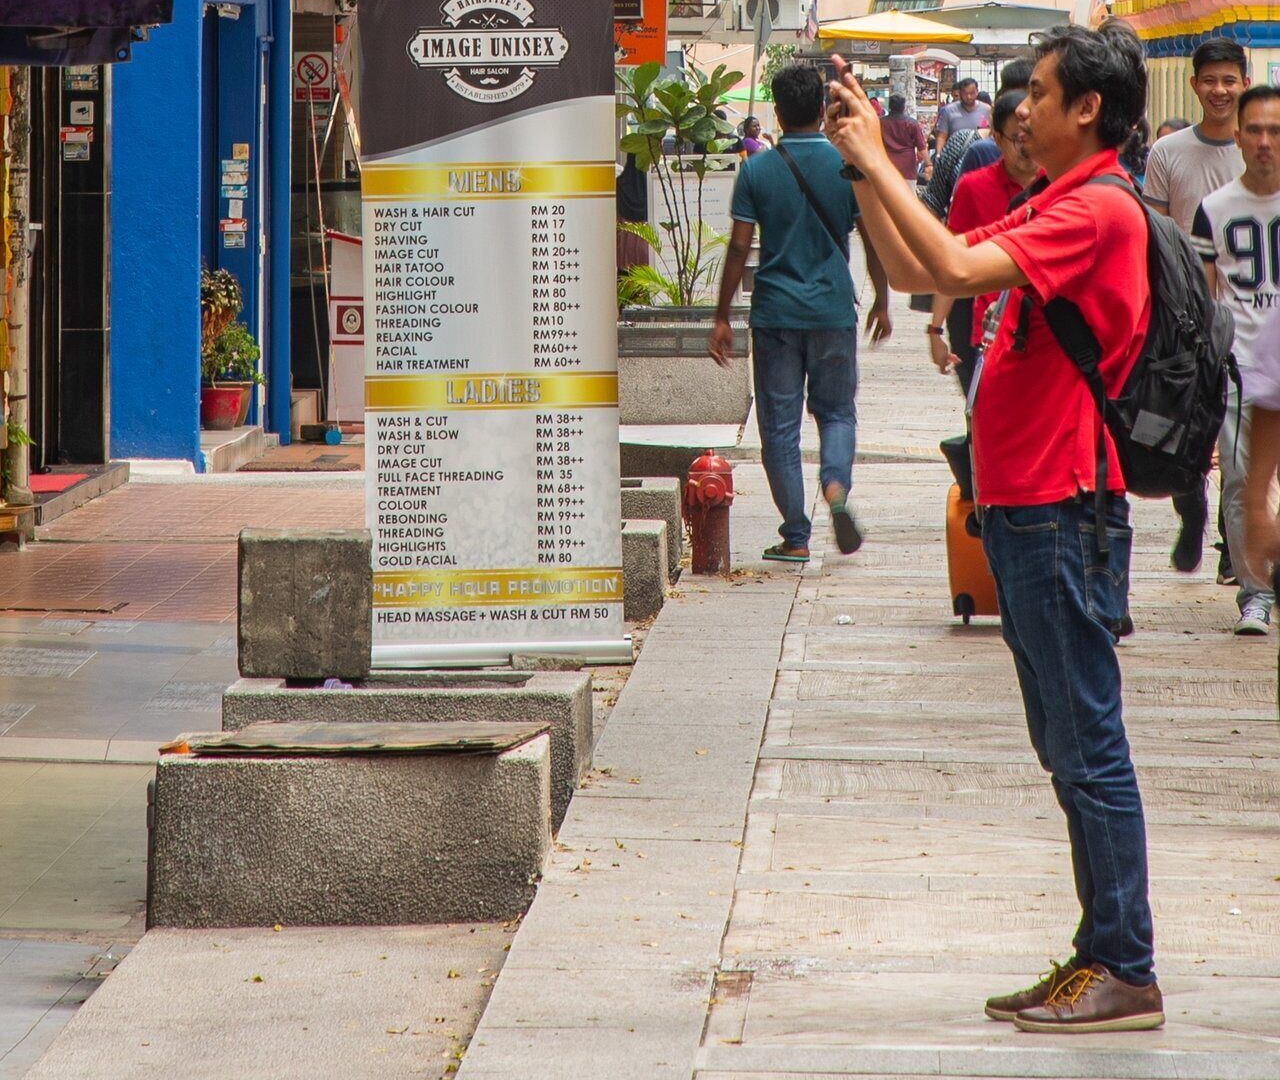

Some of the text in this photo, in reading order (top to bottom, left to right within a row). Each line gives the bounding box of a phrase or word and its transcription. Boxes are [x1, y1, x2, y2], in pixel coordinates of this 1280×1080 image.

[422, 36, 555, 58] IMAGE UNISEX
[454, 81, 526, 100] ESTABLISHED 1979
[448, 170, 522, 193] MENS
[374, 206, 565, 218] WASH & HAIR CUT RM 20
[376, 302, 580, 315] FASHION COLOUR RM 80++
[446, 378, 541, 404] LADIES
[450, 578, 617, 596] HOUR PROMOTION
[377, 608, 608, 623] HEAD MASSAGE + WASH & CUT RM 50
